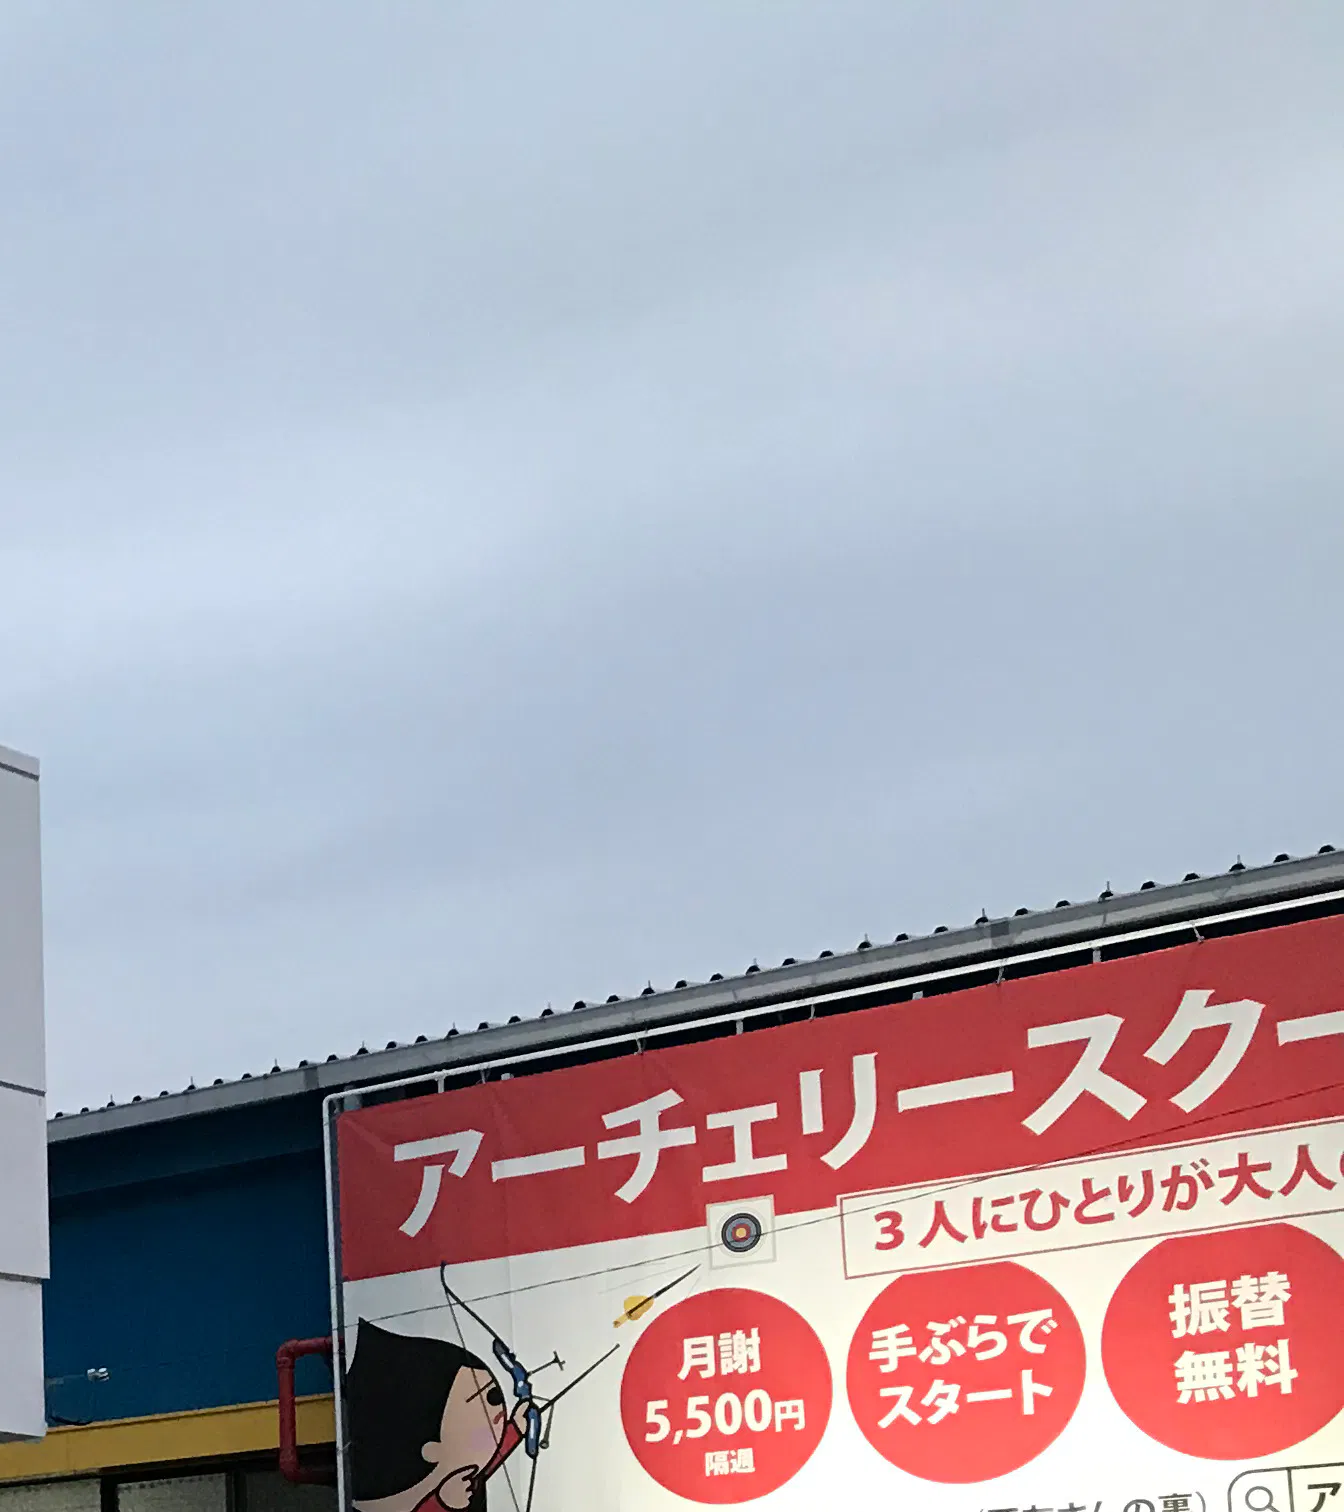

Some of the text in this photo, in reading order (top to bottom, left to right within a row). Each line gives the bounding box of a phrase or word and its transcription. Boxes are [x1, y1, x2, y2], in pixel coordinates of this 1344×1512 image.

[394, 988, 1344, 1238] アーチェリースクー
[873, 1143, 1344, 1250] 3人にひとりが大人
[1168, 1271, 1293, 1339] 振替
[677, 1327, 761, 1381] 月謝
[868, 1308, 1059, 1375] 手ぶらで
[1174, 1338, 1299, 1405] 無料
[644, 1388, 806, 1446] 5,500円
[877, 1369, 1054, 1430] スタート
[703, 1447, 756, 1477] 隔週
